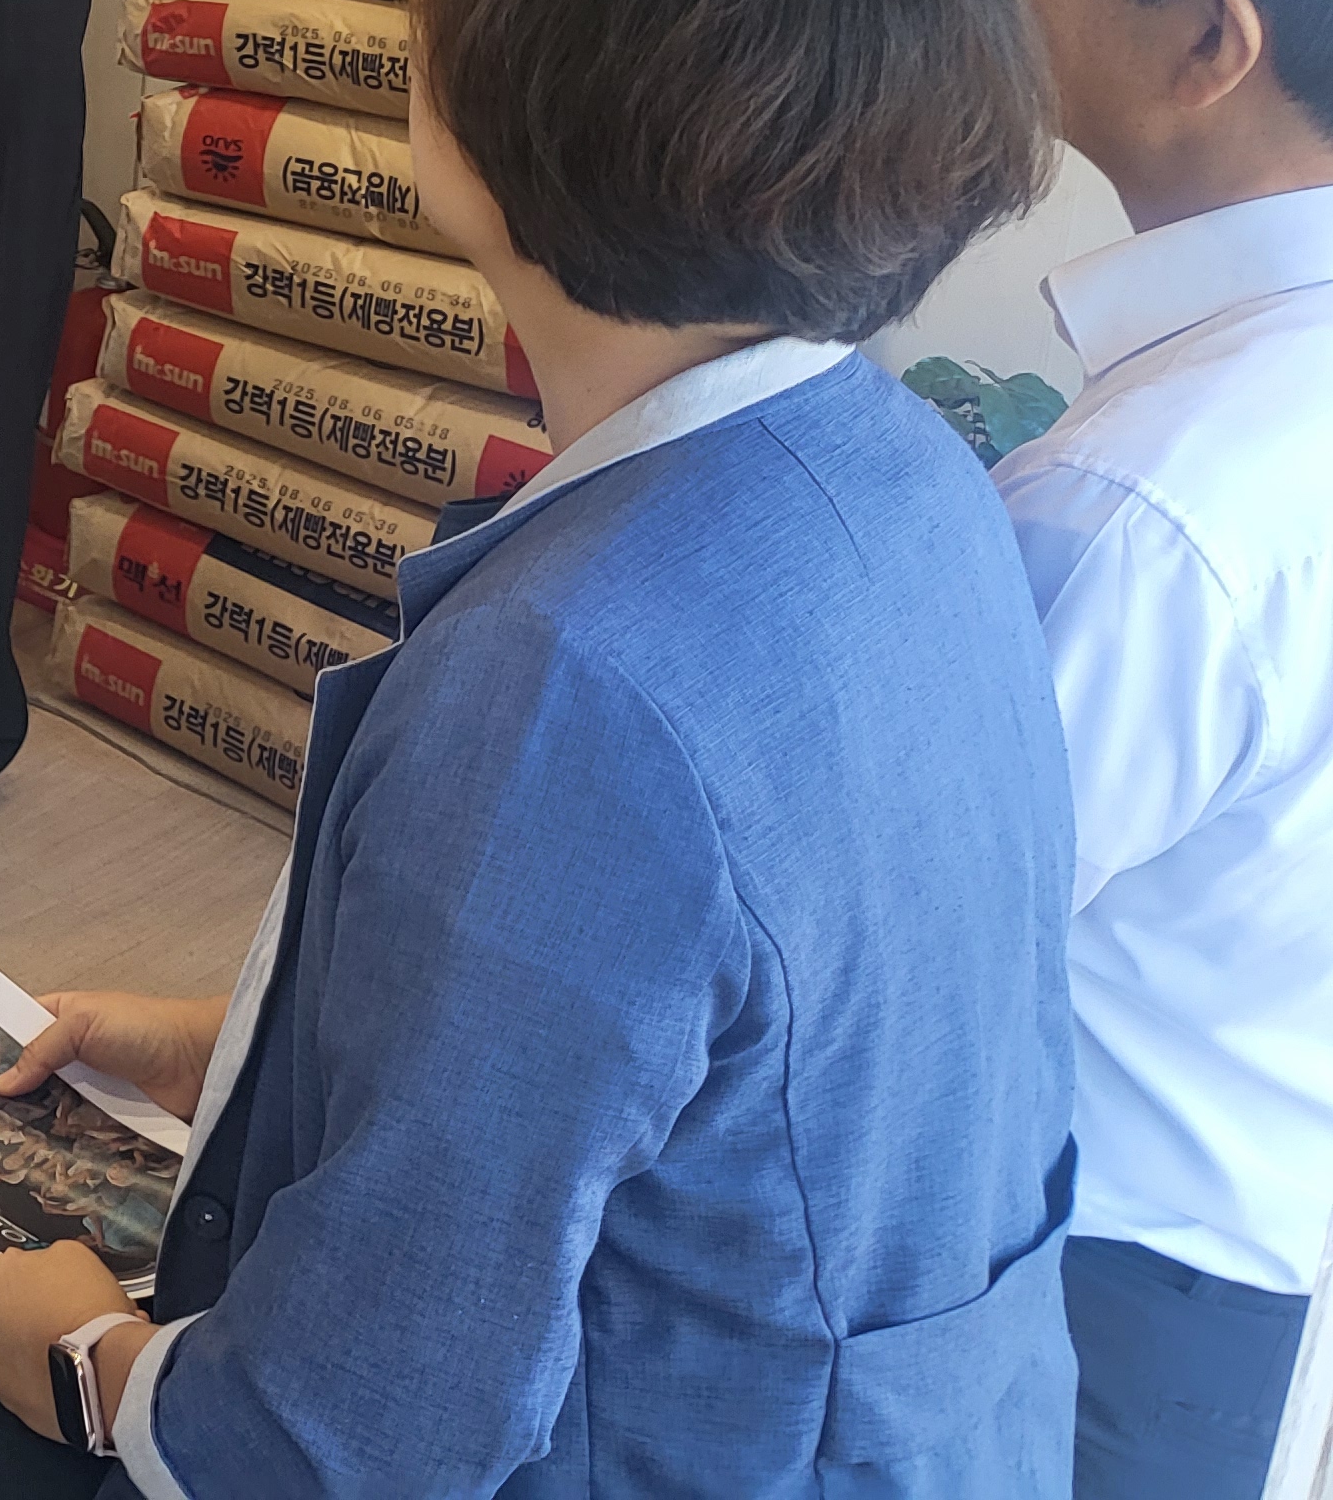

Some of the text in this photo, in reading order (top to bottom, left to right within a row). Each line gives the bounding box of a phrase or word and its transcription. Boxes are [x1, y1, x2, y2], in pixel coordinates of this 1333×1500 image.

[367, 35, 387, 49] 06
[290, 259, 403, 296] 2025. 06
[243, 260, 485, 357] 강력1등(제빵전용분)
[272, 378, 383, 420] 2025. 06
[222, 375, 458, 487] 강력1등(제빵전용분)
[226, 465, 332, 513] 2025. 06
[21, 562, 79, 598] 화기
